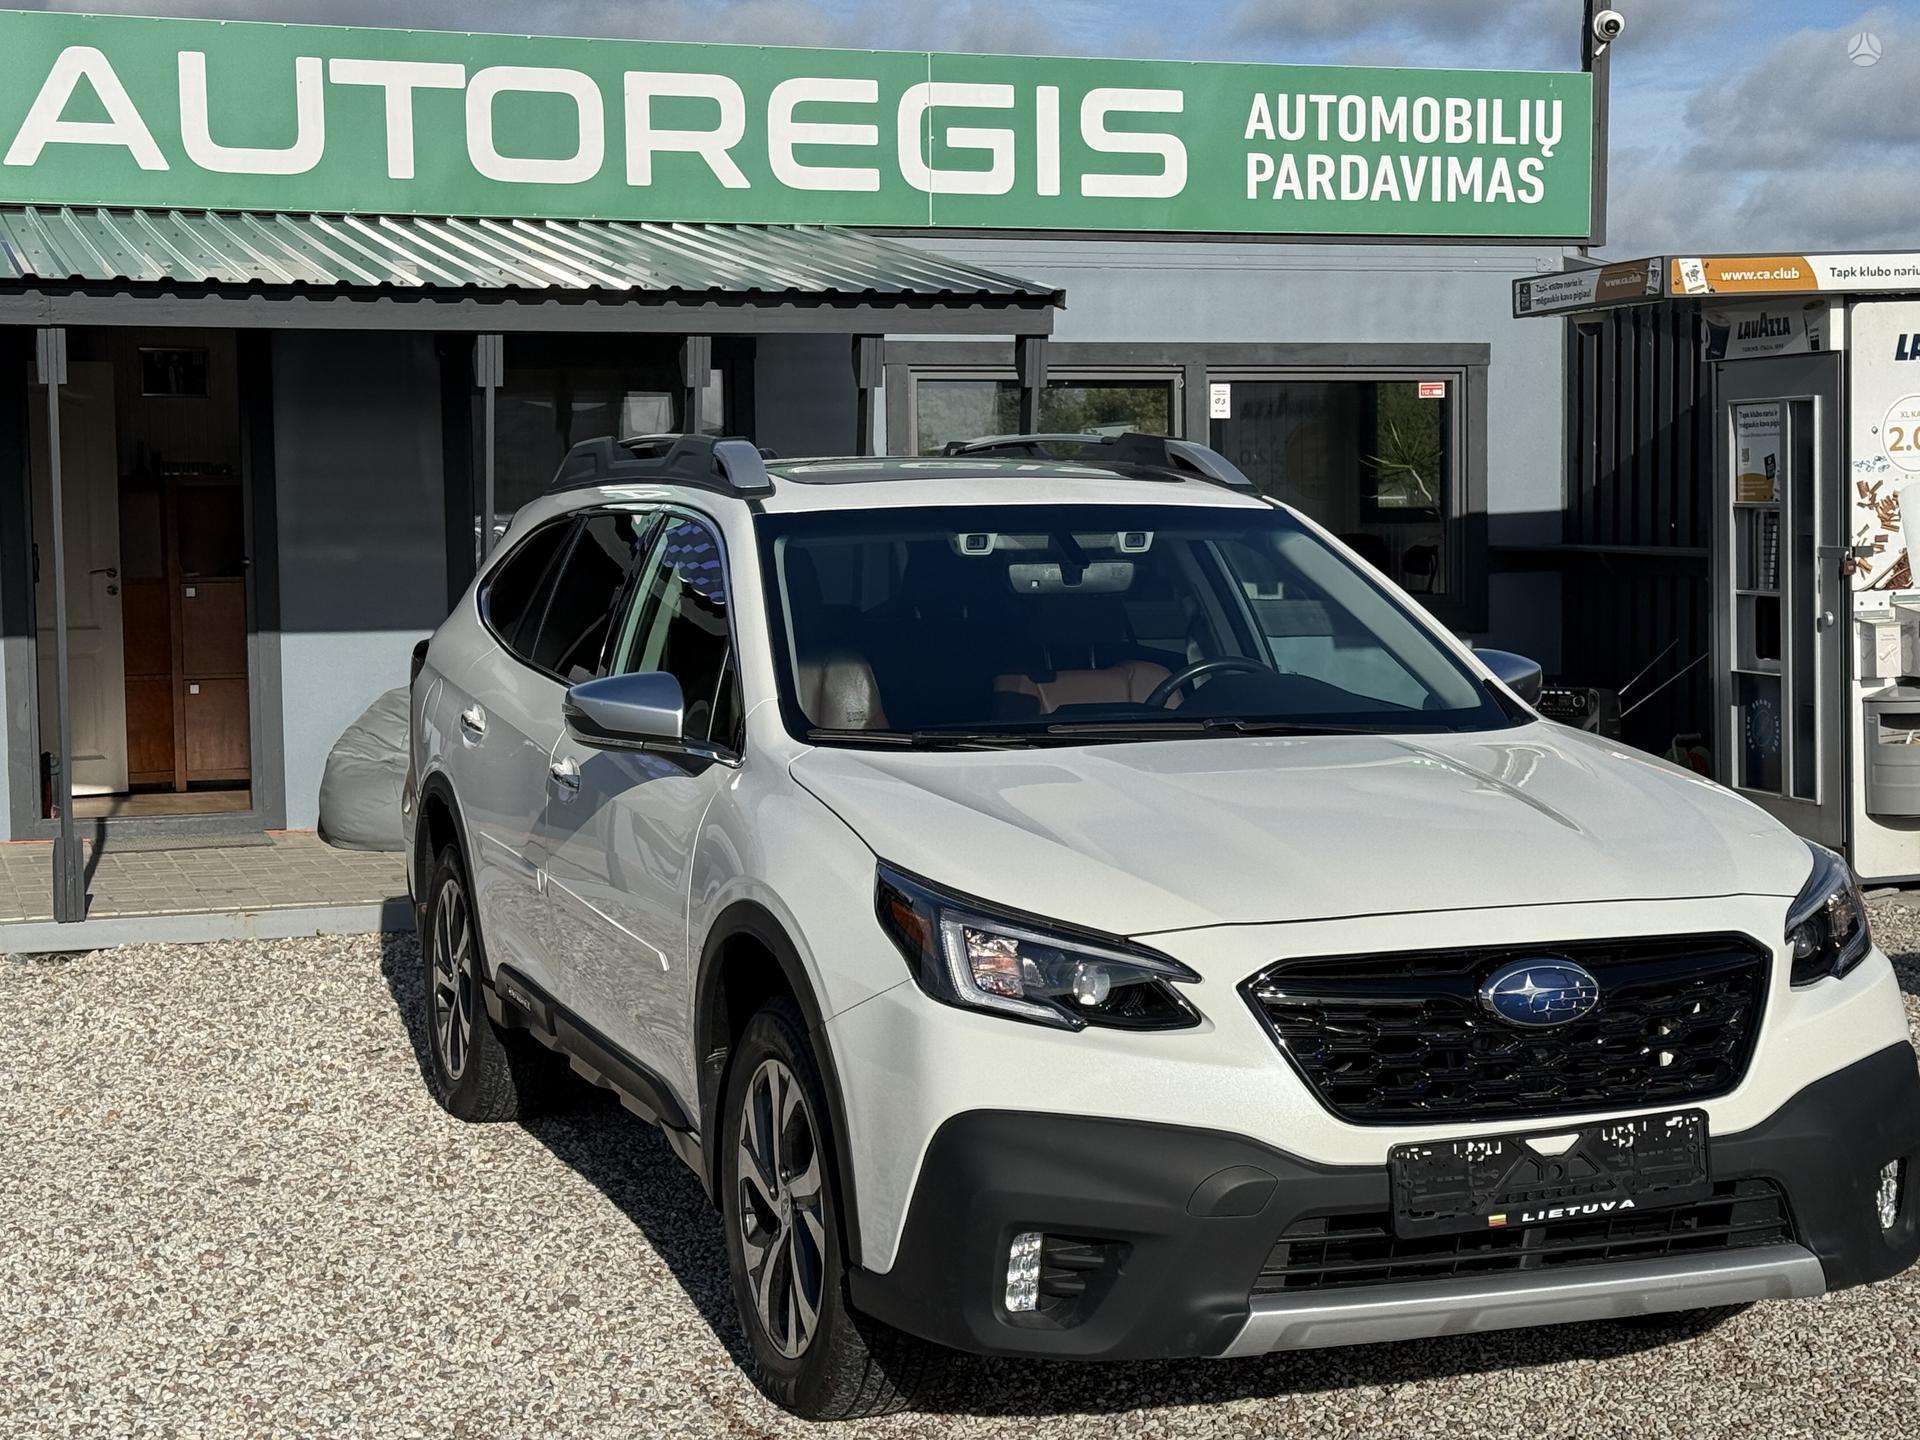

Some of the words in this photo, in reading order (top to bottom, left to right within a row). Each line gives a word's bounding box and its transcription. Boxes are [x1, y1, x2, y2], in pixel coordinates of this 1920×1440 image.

[3, 46, 1188, 198] AUTOREGIS
[1244, 93, 1563, 158] AUTOMOBILIŲ
[1246, 152, 1545, 204] PARDAVIMAS
[1720, 265, 1800, 282] www.ca.club
[1829, 266, 1857, 280] Tapk
[1860, 266, 1891, 277] klubo
[1737, 312, 1791, 340] LAVAZZA
[1521, 1199, 1636, 1223] LIETUVA
